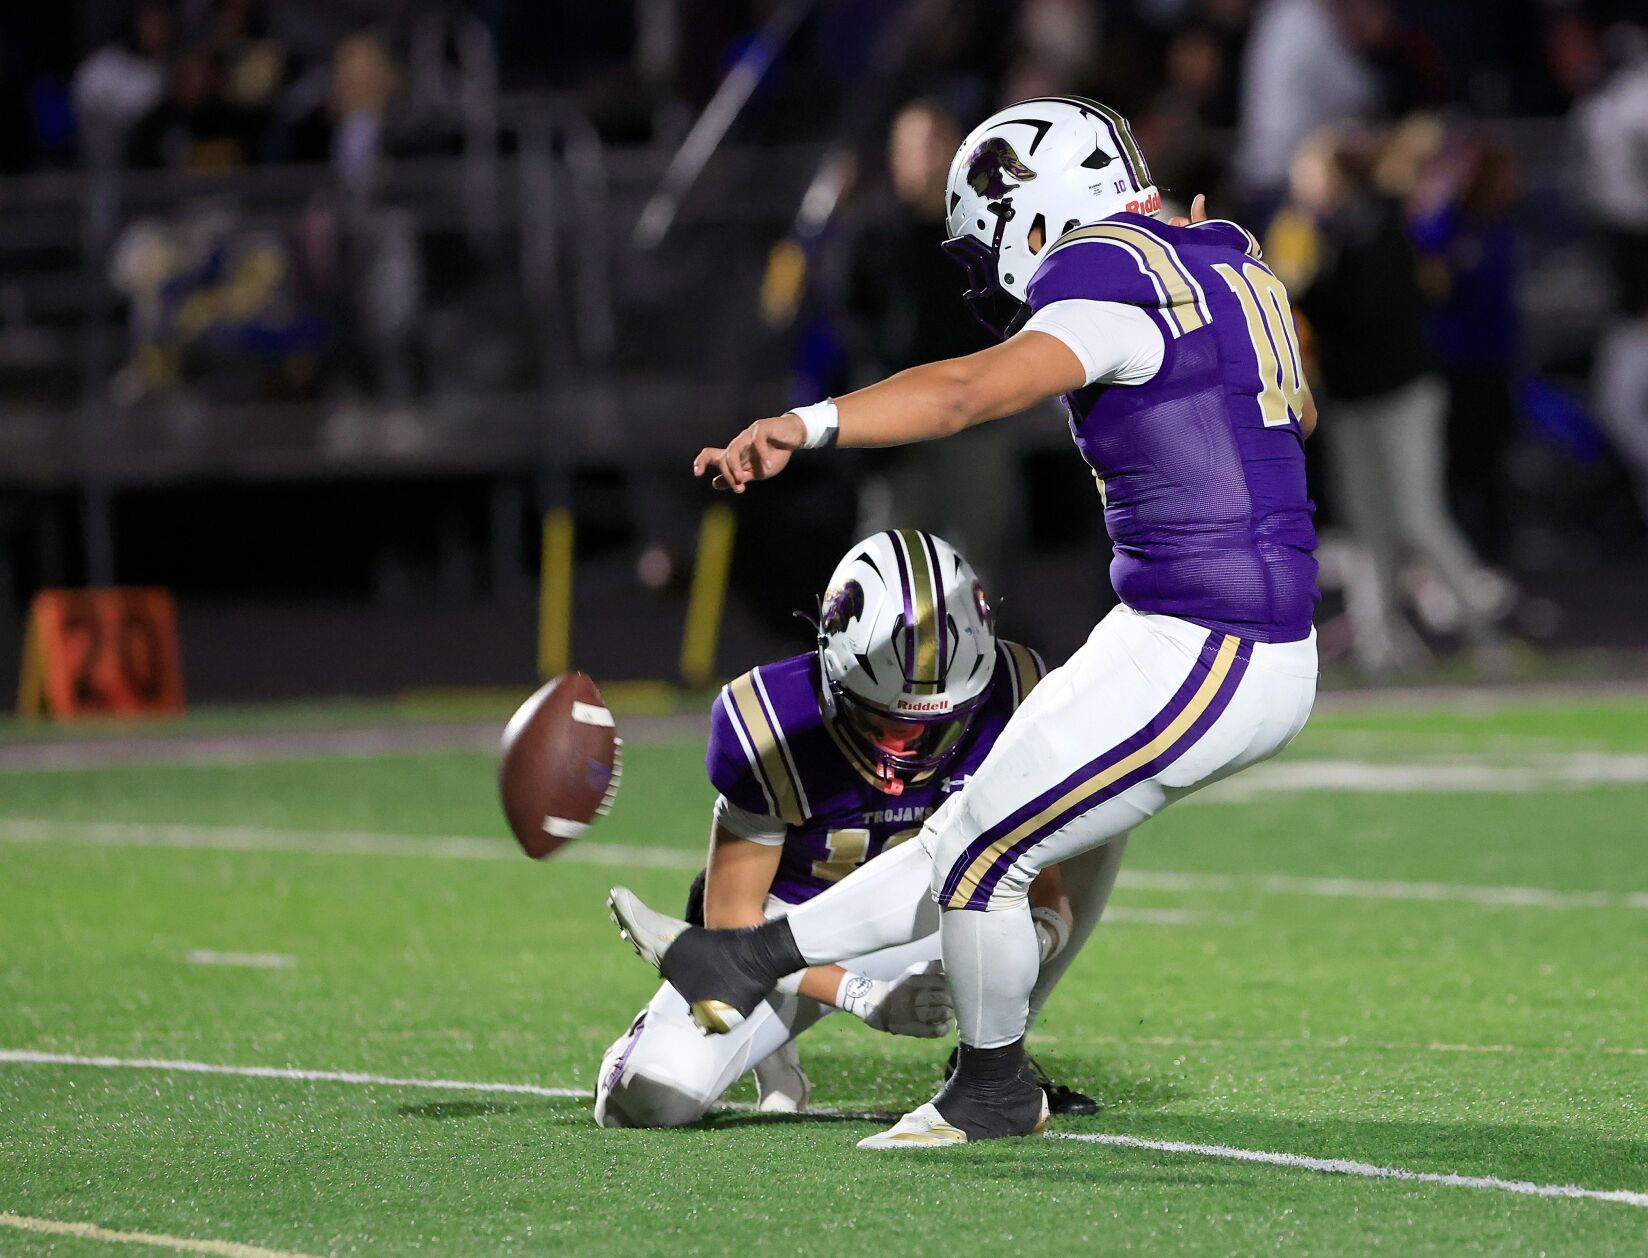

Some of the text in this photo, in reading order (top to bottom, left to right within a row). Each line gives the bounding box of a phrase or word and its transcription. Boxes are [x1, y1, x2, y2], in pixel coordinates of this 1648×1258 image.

[1114, 180, 1127, 194] 10
[1210, 262, 1303, 427] 10
[60, 592, 164, 711] 20
[897, 700, 949, 711] Riddell
[811, 827, 922, 882] 1
